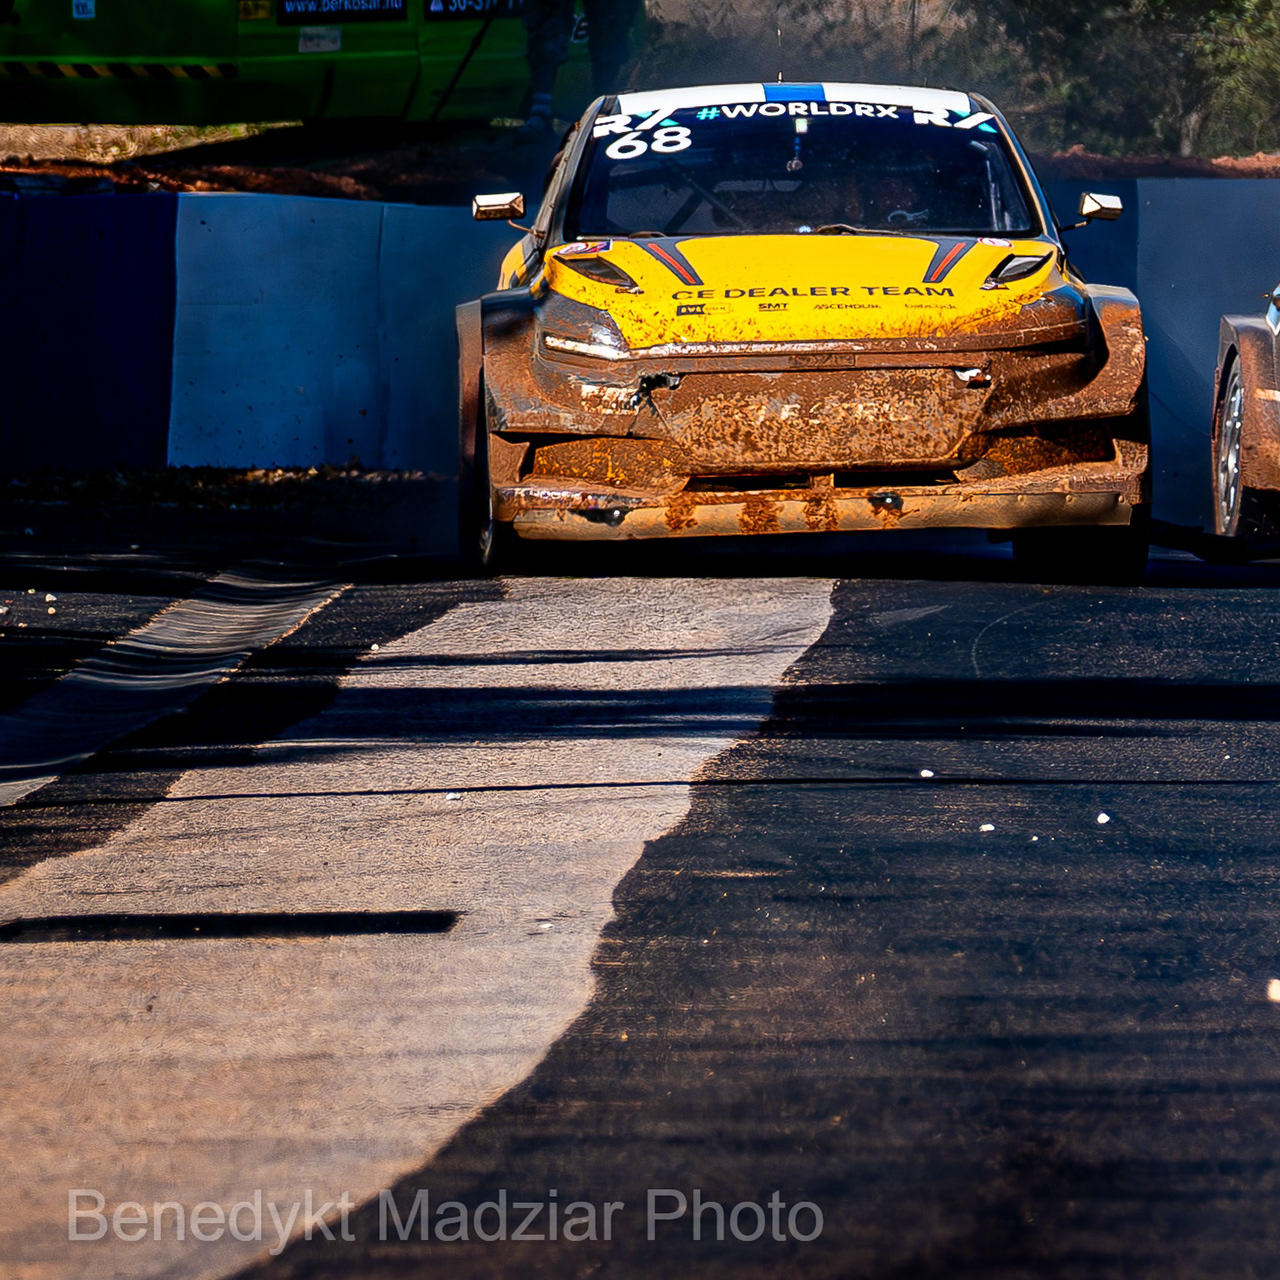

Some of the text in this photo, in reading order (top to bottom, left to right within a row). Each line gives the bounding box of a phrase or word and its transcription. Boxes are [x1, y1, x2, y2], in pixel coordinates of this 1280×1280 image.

[696, 101, 900, 121] #WORLDRX
[605, 126, 692, 160] 68
[672, 286, 955, 300] CE DEALER TEAM
